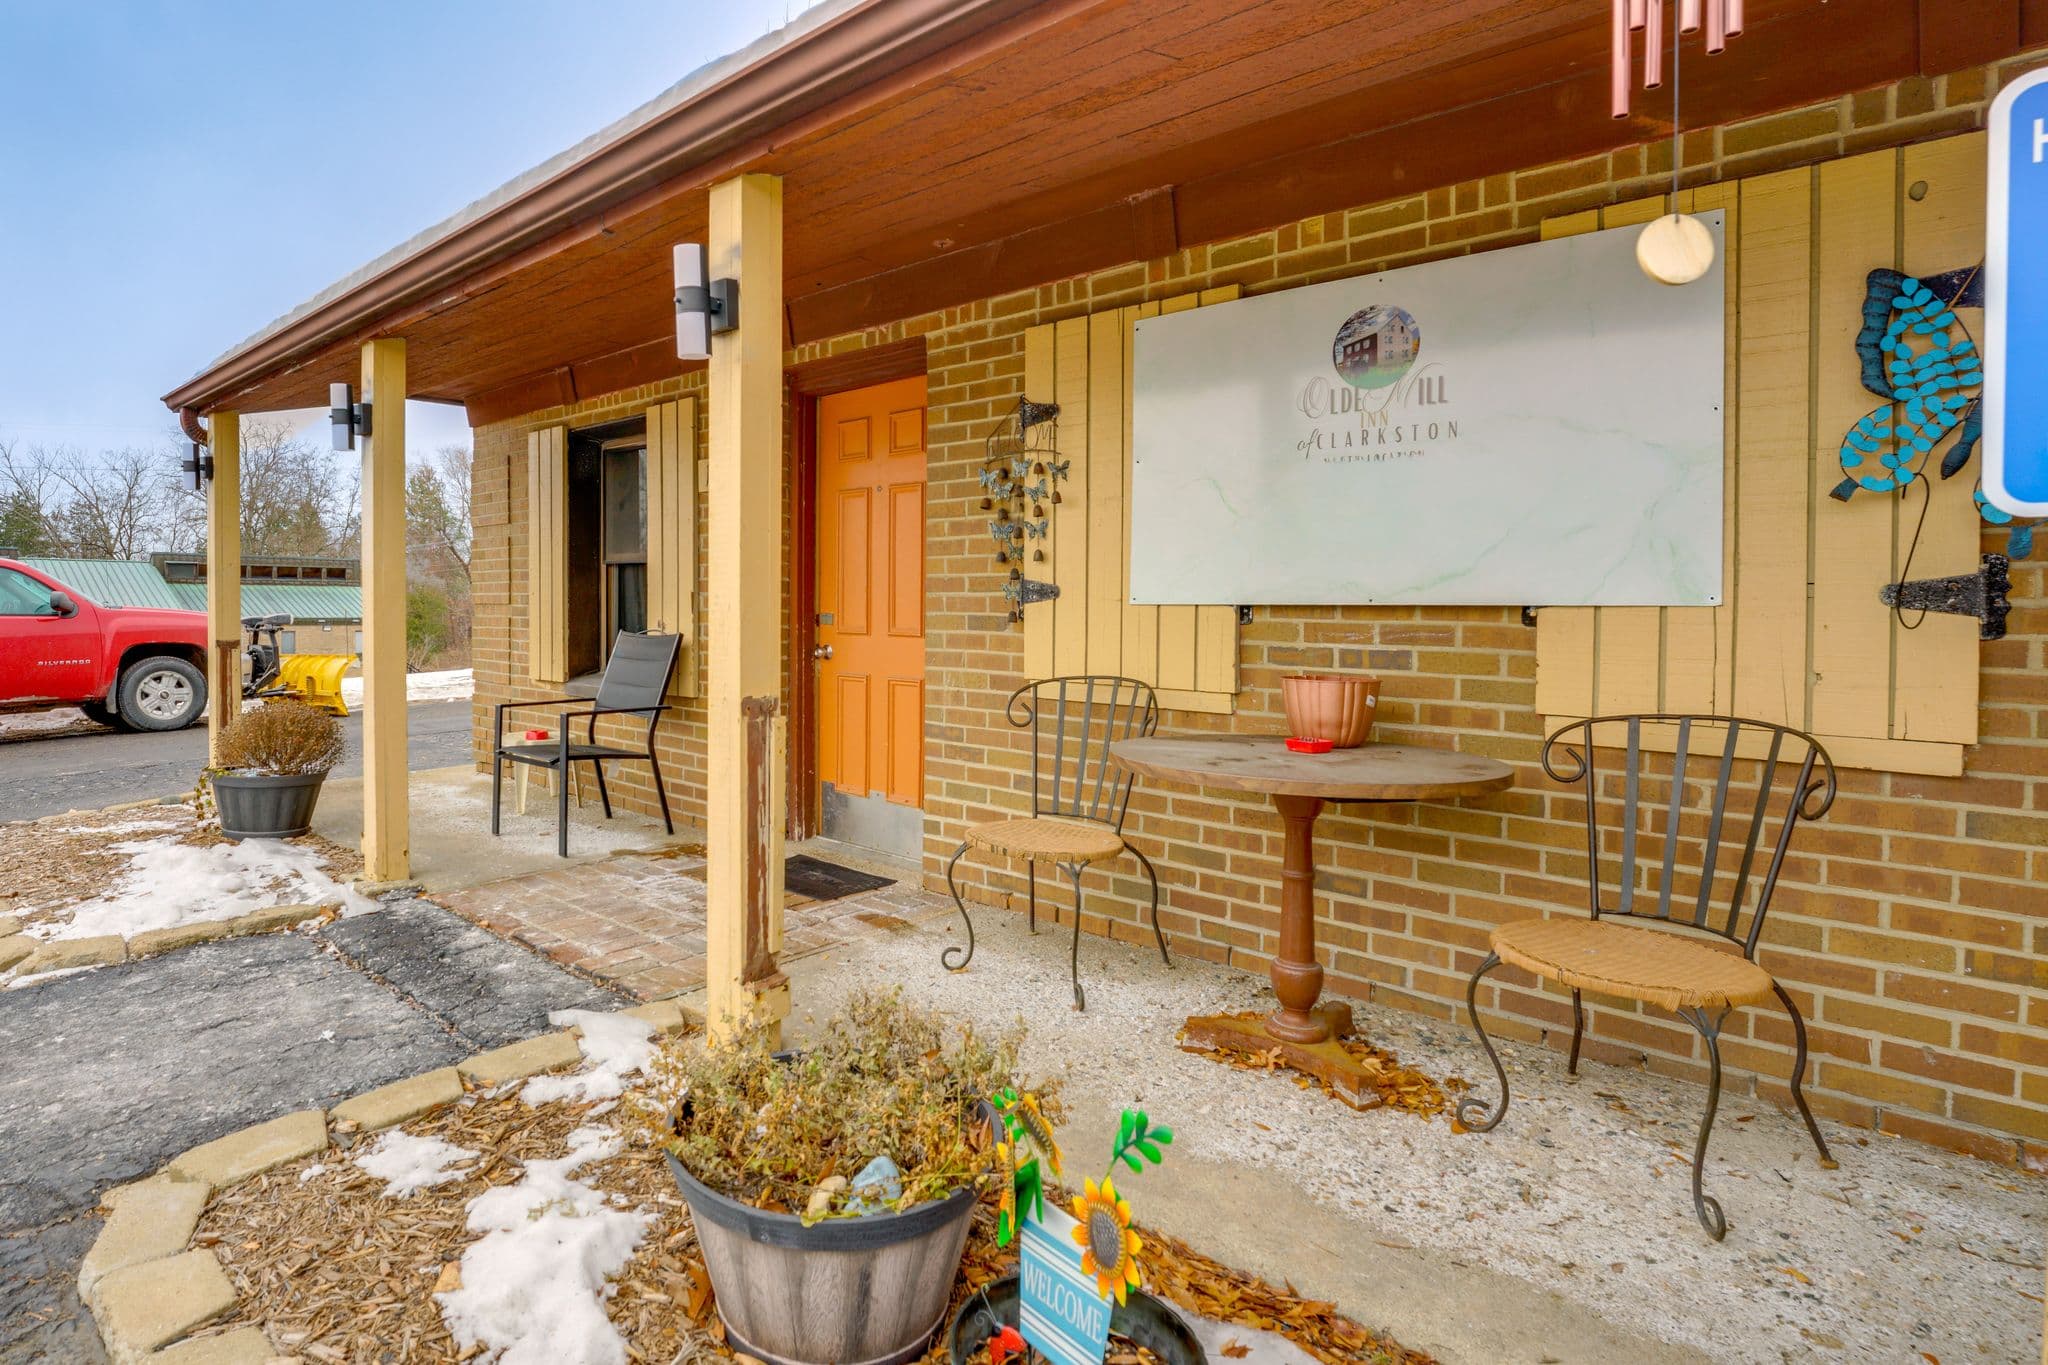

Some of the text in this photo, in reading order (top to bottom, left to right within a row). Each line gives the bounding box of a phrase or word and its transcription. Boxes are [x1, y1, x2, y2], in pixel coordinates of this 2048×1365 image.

[1297, 376, 1363, 419] OLDE
[1316, 420, 1459, 450] CLARKSTON
[1360, 410, 1389, 429] INN
[1023, 1257, 1104, 1345] WELCOME
